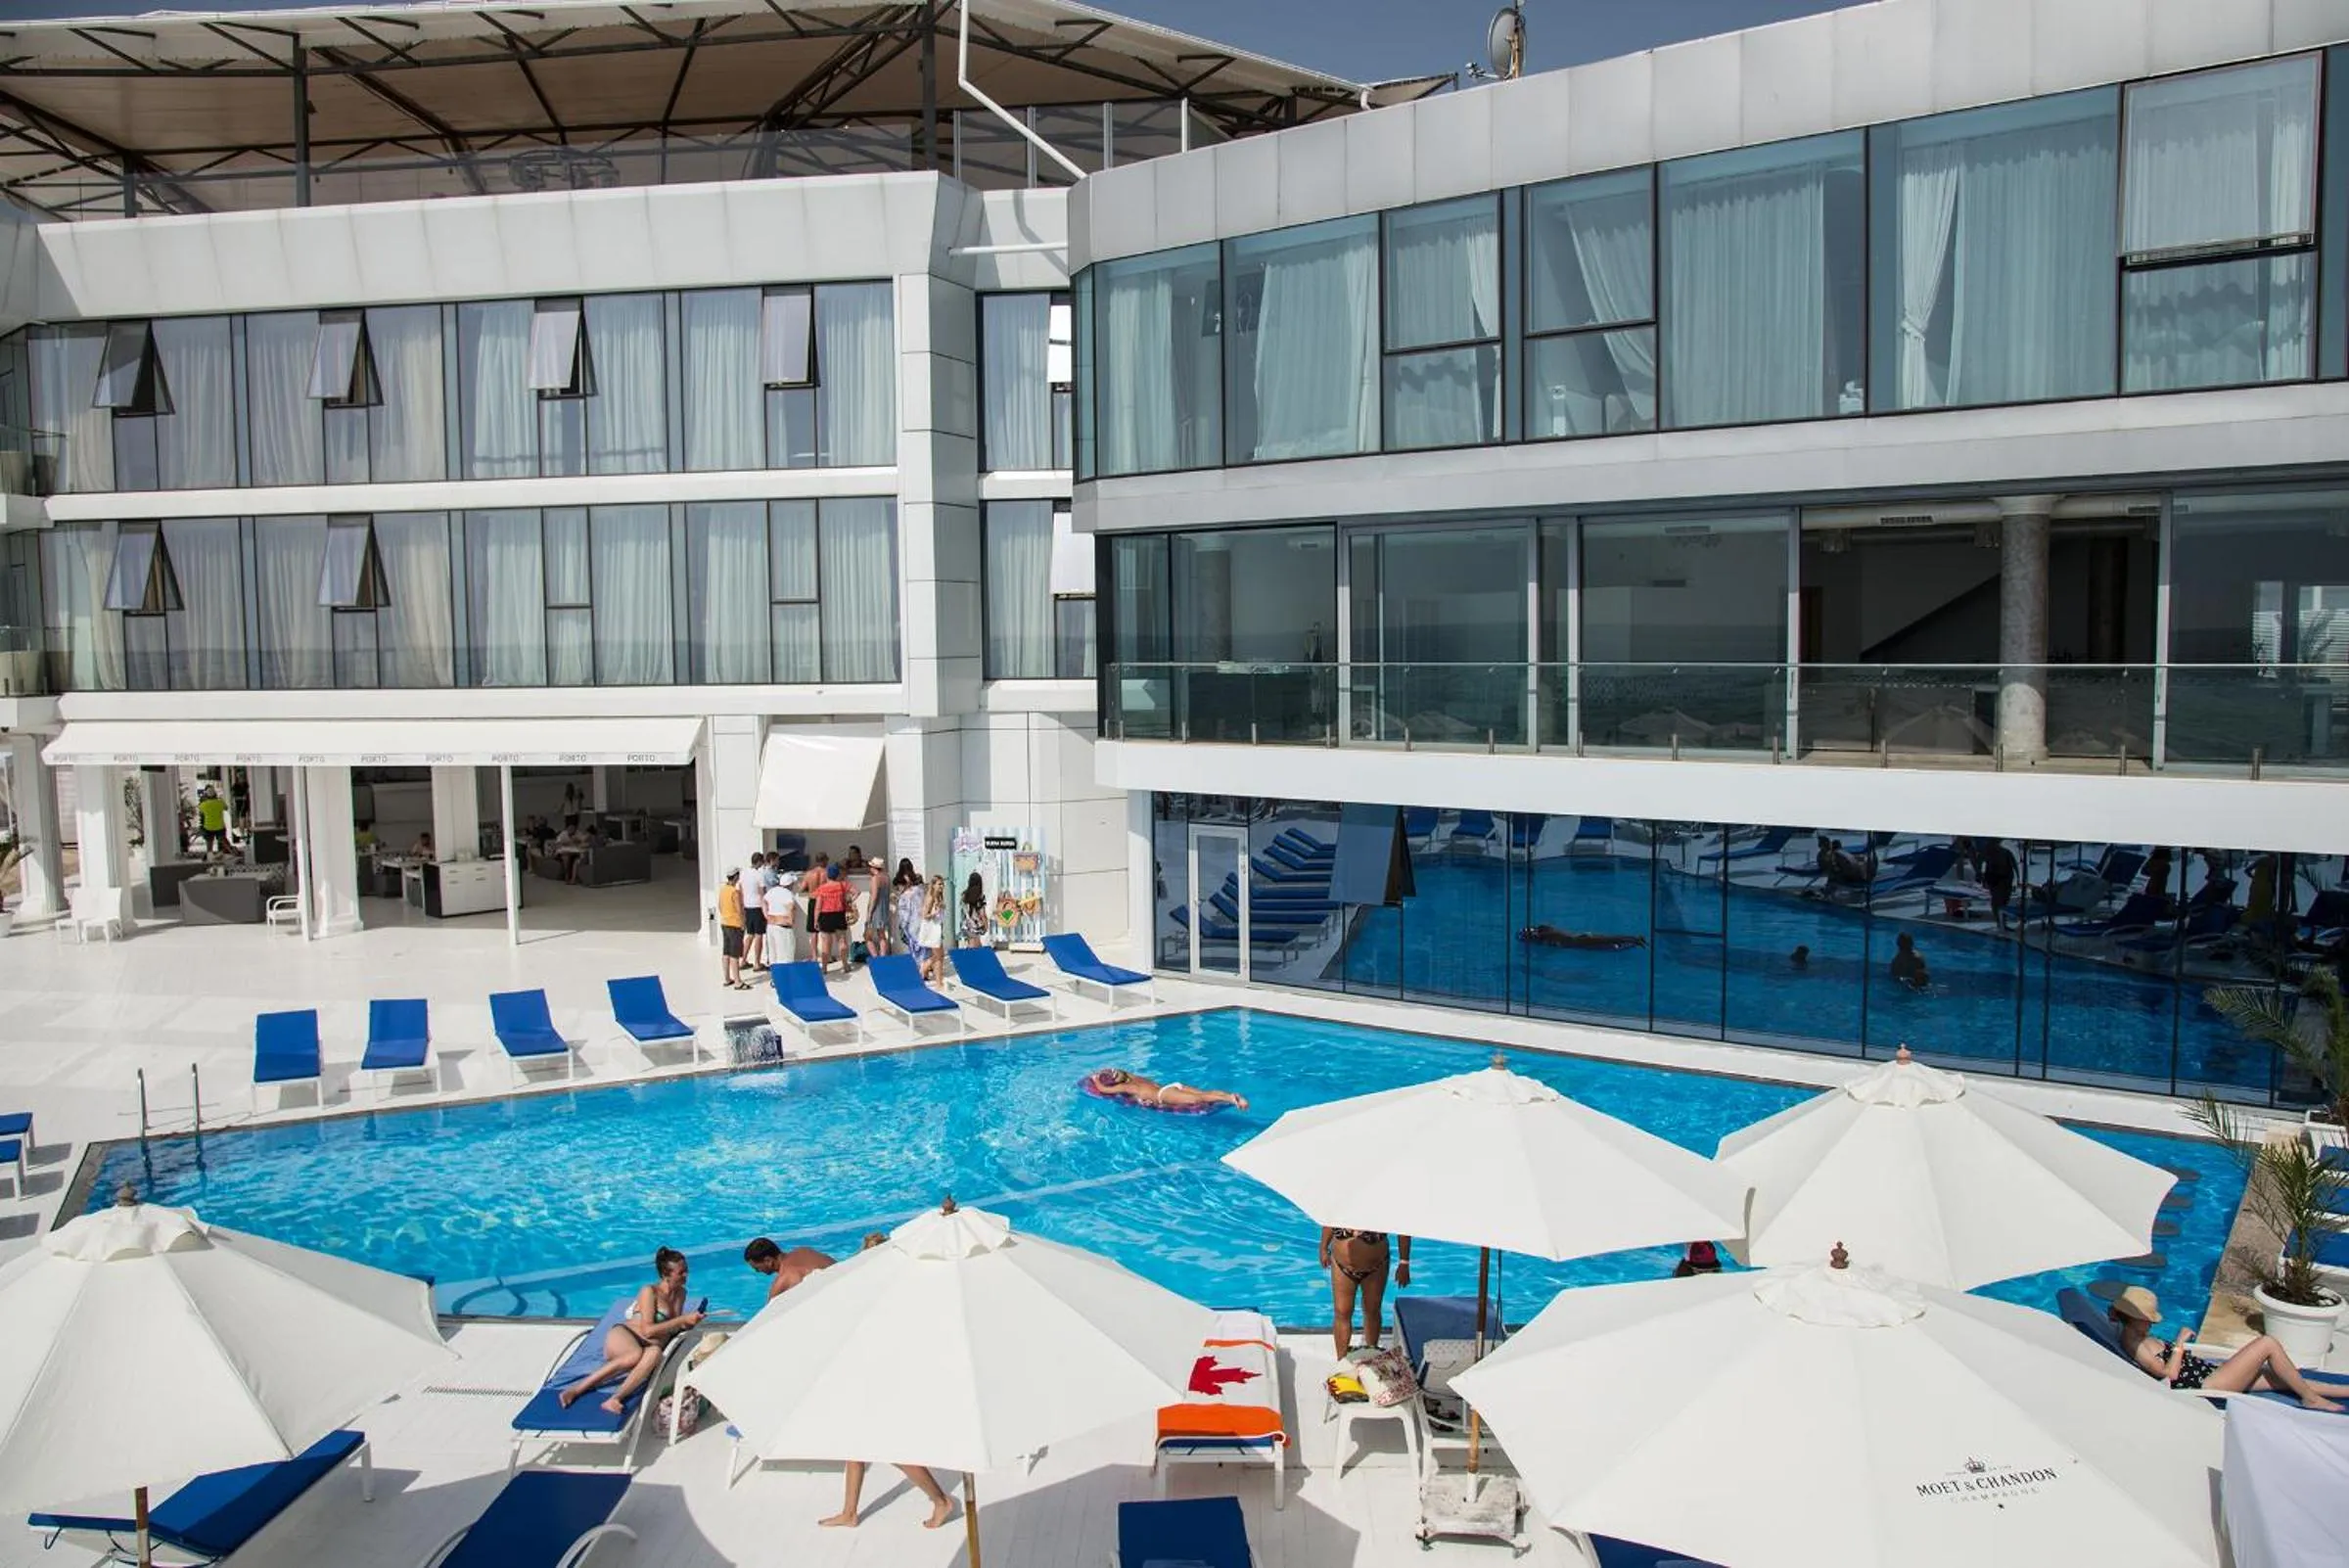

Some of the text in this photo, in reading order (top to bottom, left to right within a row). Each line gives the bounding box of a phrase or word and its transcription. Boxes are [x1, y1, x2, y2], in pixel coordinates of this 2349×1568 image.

[360, 754, 389, 762] PORTO
[490, 754, 520, 762] PORTO
[559, 754, 587, 762] PORTO
[626, 754, 656, 762] PORTO
[1915, 1480, 1960, 1497] MOET
[1963, 1481, 1975, 1492] &
[1976, 1467, 2057, 1490] CHANDON
[1949, 1488, 2041, 1503] CHAMPAGNE
